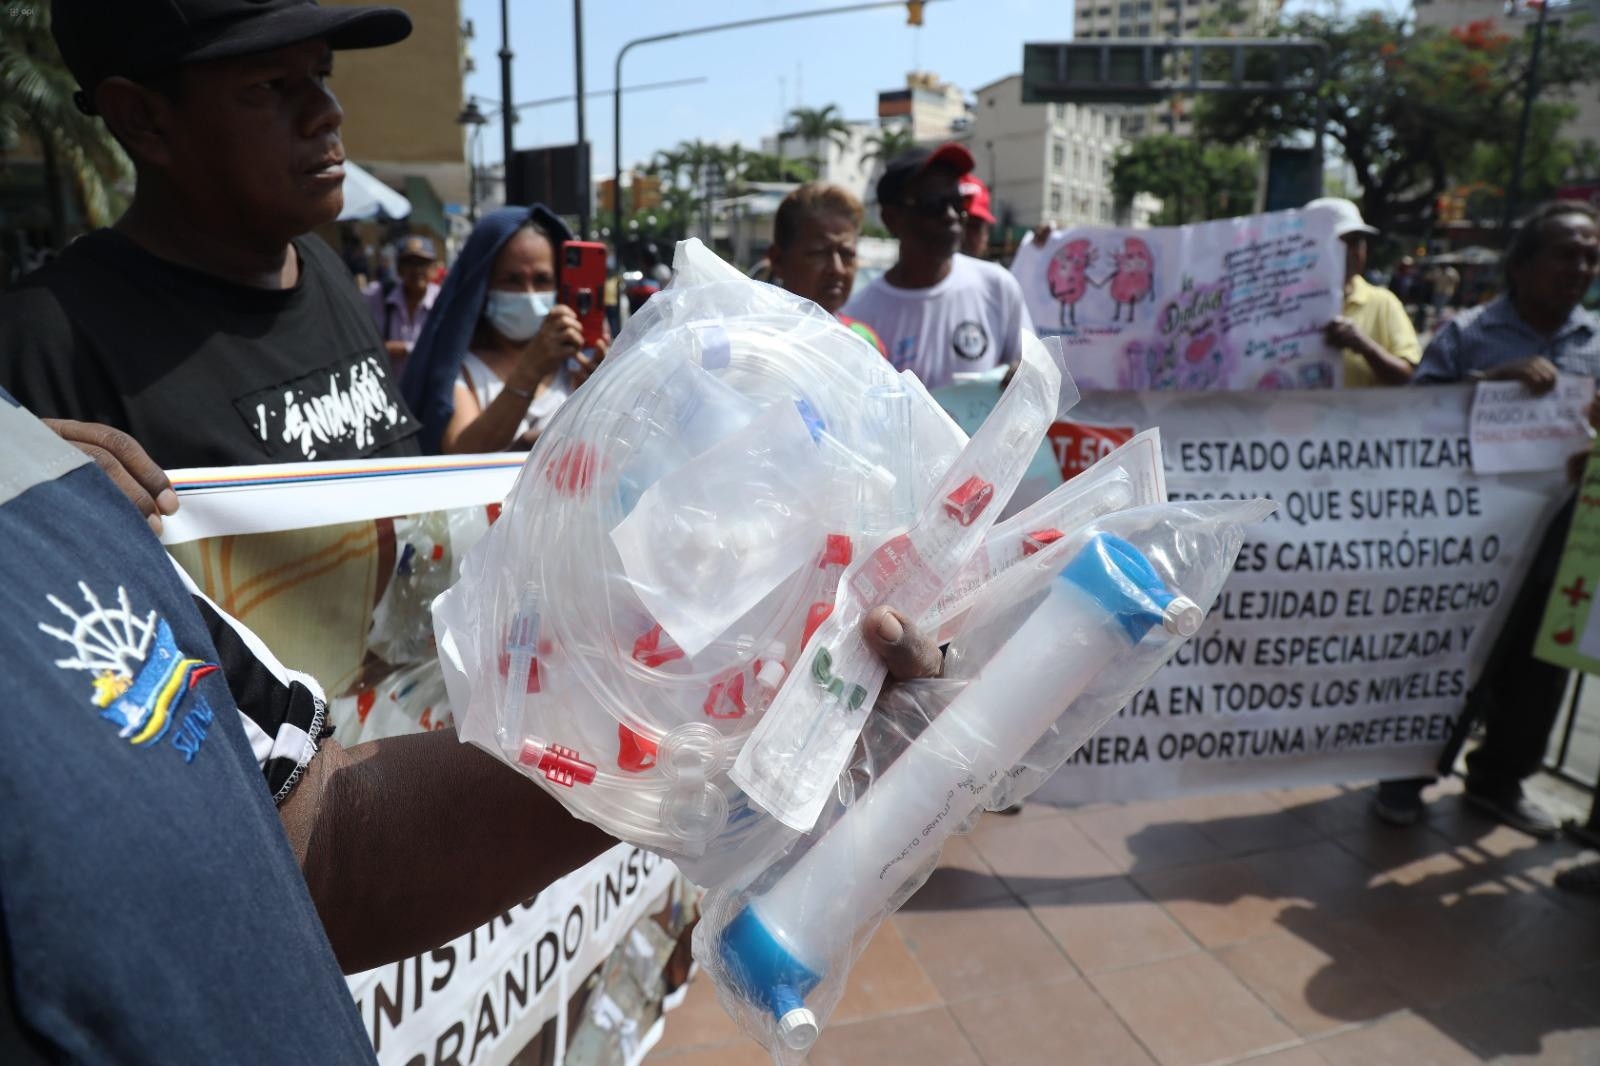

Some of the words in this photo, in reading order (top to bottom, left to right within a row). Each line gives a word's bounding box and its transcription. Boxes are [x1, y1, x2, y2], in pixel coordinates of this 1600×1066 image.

[1181, 441, 1289, 472] ESTADO
[1298, 438, 1473, 471] GARANTIZAR
[1286, 490, 1342, 526] QUE
[1351, 488, 1438, 520] SUFRA
[1446, 486, 1482, 516] DE
[1276, 529, 1473, 571] CATASTRÓFICA
[1481, 534, 1500, 563] O
[1346, 588, 1375, 617] EL
[1383, 579, 1499, 616] DERECHO
[1254, 628, 1452, 666] ESPECIALIZADA
[1461, 624, 1475, 652] Y
[1169, 686, 1204, 716] EN
[1212, 681, 1304, 712] TODOS
[1310, 678, 1361, 708] LOS
[1158, 725, 1305, 761] OPORTUNA
[1315, 723, 1330, 749] Y
